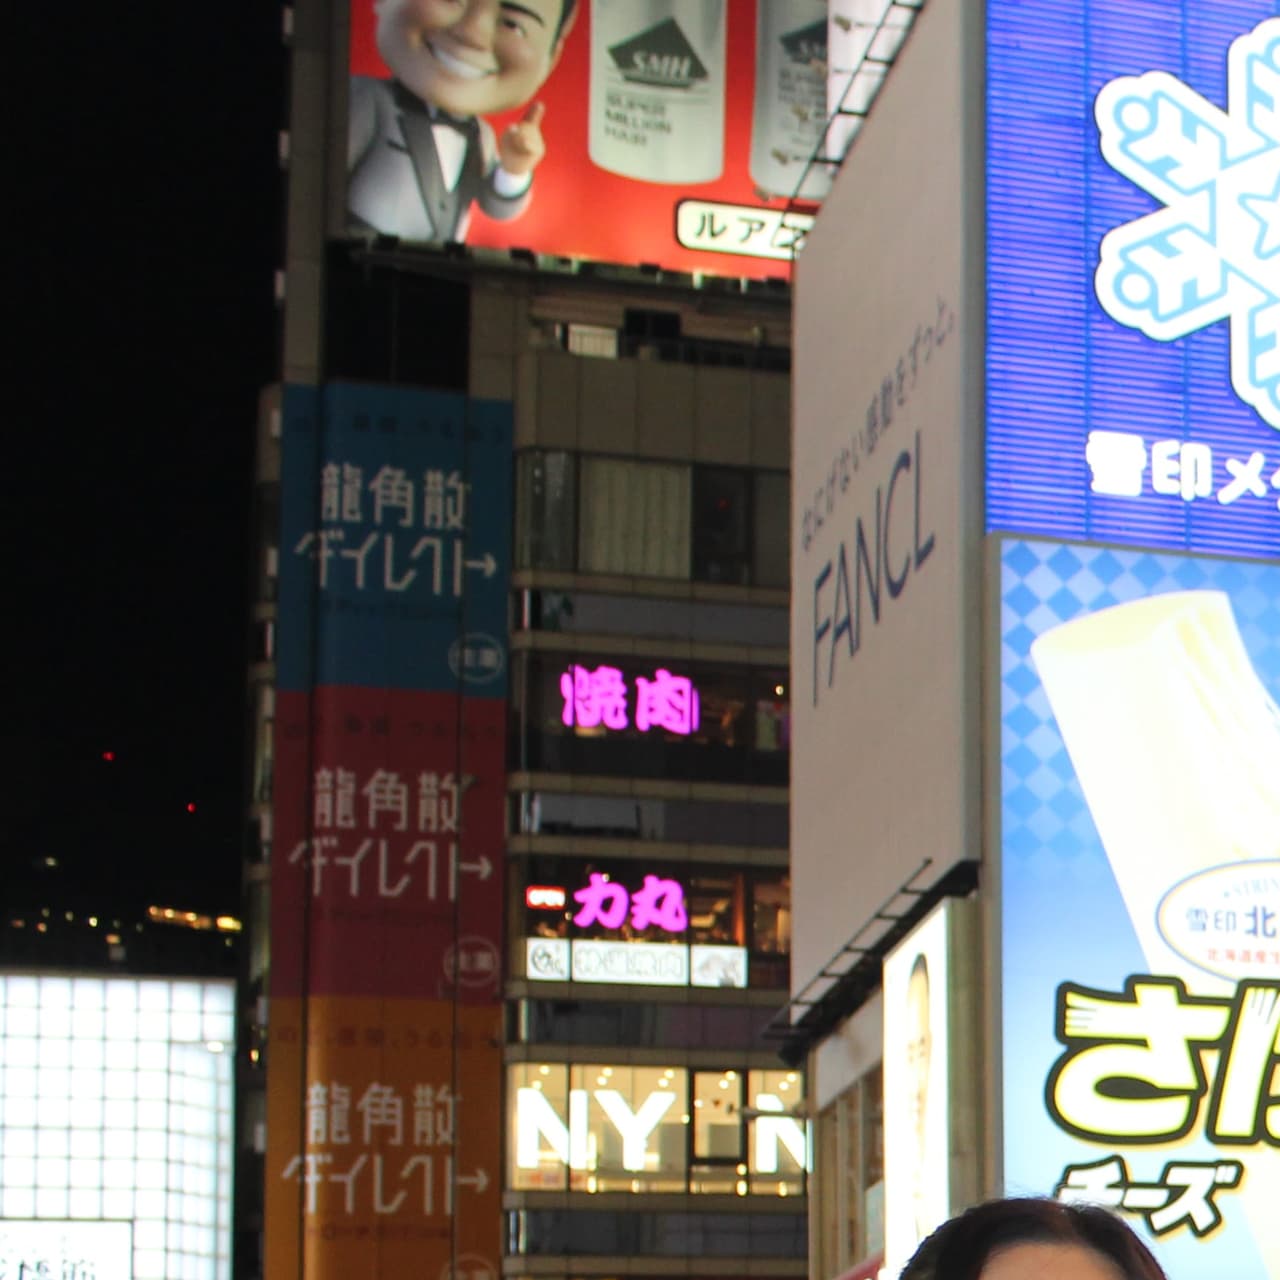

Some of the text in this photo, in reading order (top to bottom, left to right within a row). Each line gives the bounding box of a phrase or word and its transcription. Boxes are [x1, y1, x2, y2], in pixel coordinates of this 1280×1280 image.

[632, 50, 692, 82] SMH
[321, 460, 470, 530] 龍角散
[812, 430, 935, 709] FANCL
[560, 665, 700, 735] 焼肉
[313, 766, 469, 832] 龍角散
[573, 872, 688, 932] 力丸
[306, 1082, 462, 1147] 龍角散
[516, 1087, 677, 1171] NY
[1056, 1155, 1244, 1240] チーズ
